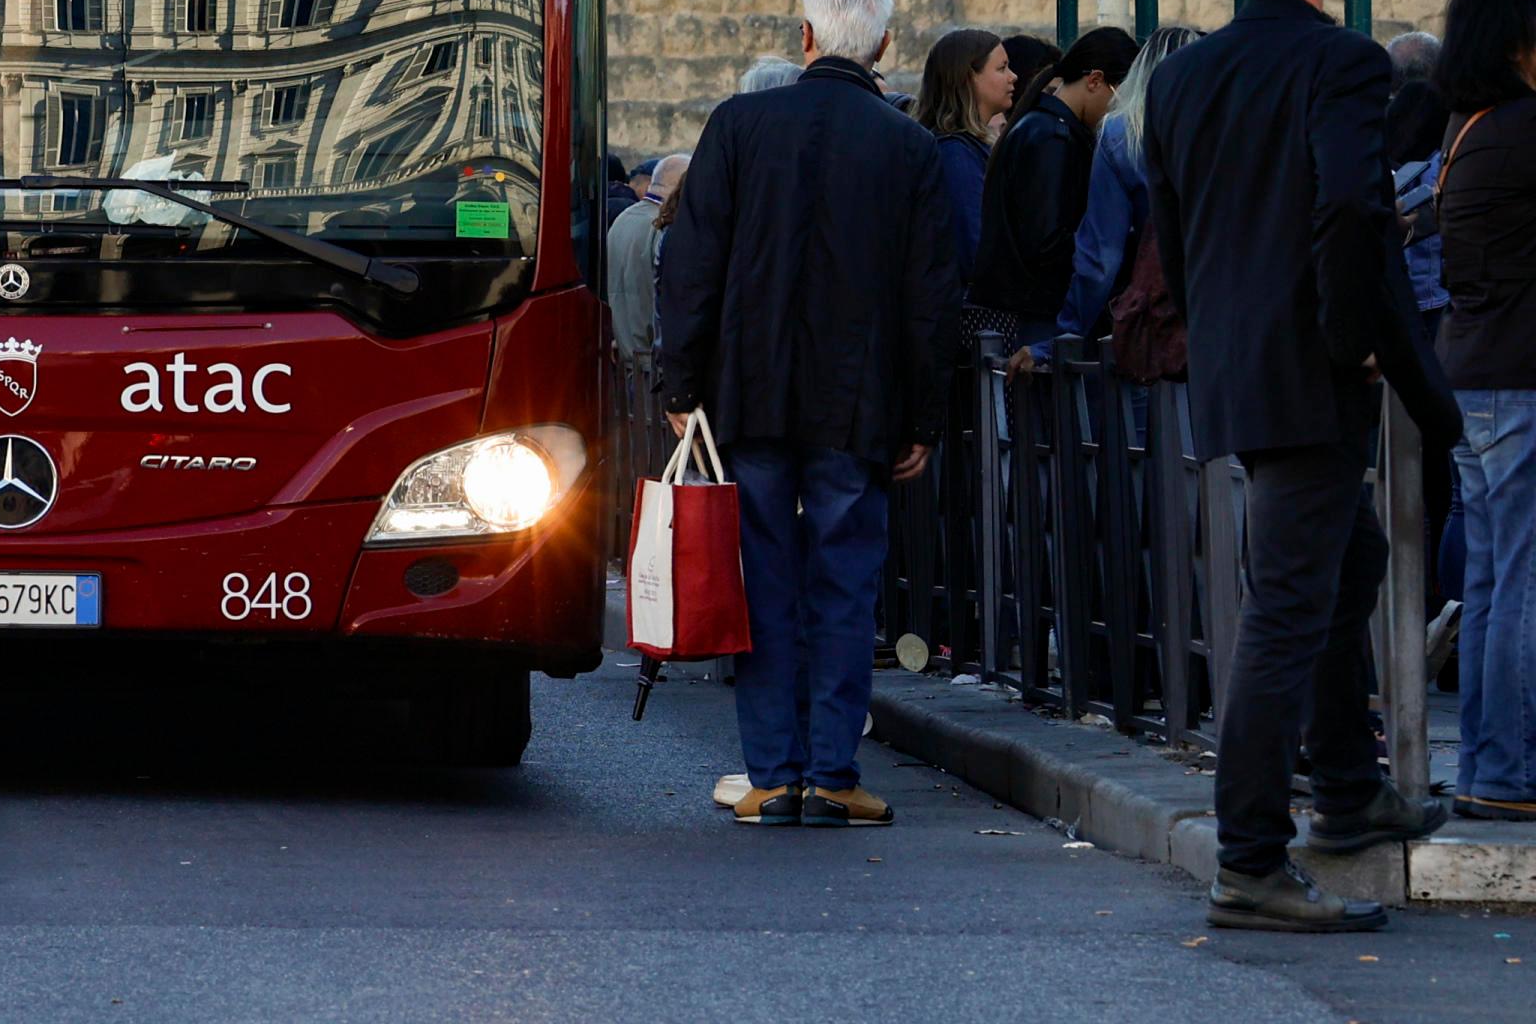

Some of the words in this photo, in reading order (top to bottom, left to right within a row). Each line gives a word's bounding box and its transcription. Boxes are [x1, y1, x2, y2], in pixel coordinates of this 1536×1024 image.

[120, 351, 293, 414] atac
[139, 453, 257, 471] CITARO
[220, 570, 313, 621] 848
